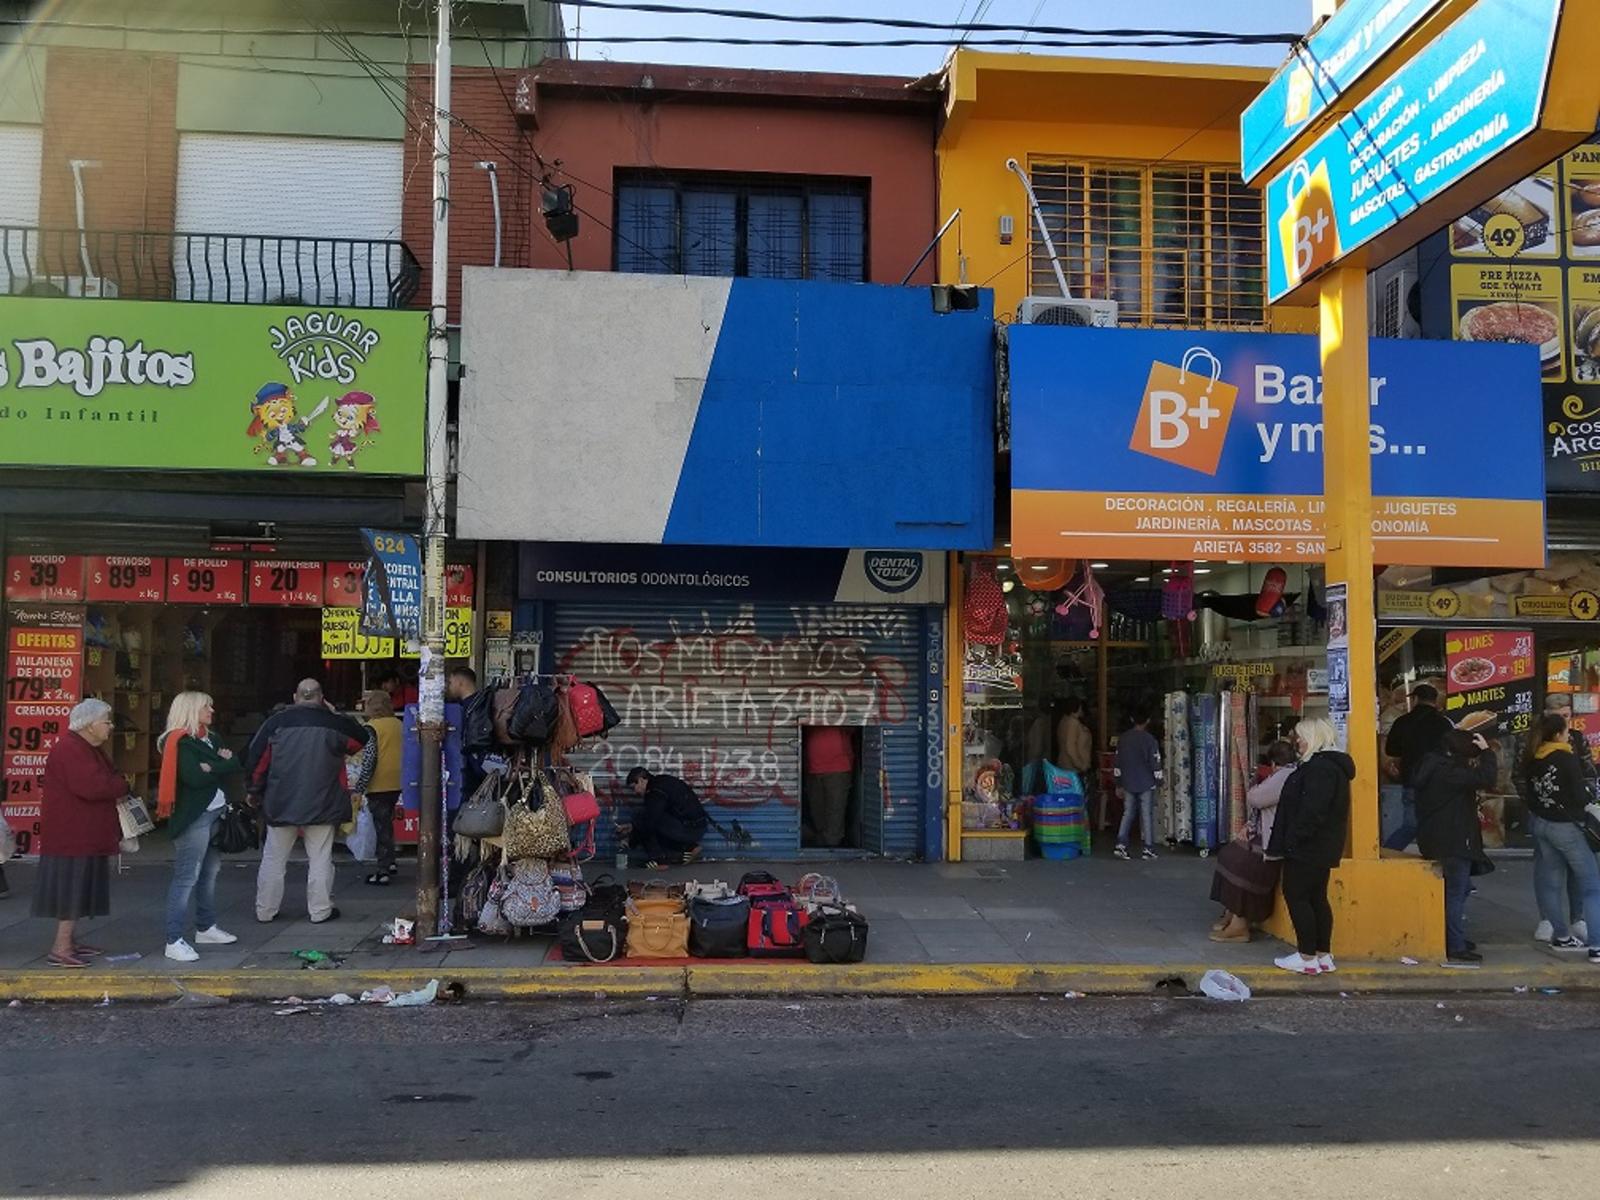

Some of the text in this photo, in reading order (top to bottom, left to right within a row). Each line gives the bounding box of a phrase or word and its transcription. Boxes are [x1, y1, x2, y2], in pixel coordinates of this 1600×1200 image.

[1428, 38, 1487, 102] LIMPIEZA
[1430, 69, 1505, 140] JARDINERÍA
[1414, 113, 1509, 184] GASTRONOMÍA
[1490, 228, 1516, 246] 49
[1480, 271, 1542, 282] PRE PIZZA
[1504, 282, 1542, 291] TOMATE
[268, 312, 381, 354] JAGUAR
[13, 335, 195, 397] Bajitos
[1255, 364, 1386, 406] Bar
[45, 407, 158, 423] Infantil
[1256, 423, 1427, 462] y ms...
[1105, 496, 1204, 512] DECORACIÓN
[1216, 498, 1297, 513] REGALERÍA
[1383, 502, 1457, 516] JUGUETES
[1136, 515, 1220, 530] JARDINERÍA
[1232, 518, 1312, 531] MASCOTAS
[374, 536, 405, 555] 624
[1193, 541, 1244, 553] ARIETA
[1248, 542, 1282, 554] 3582
[106, 556, 151, 566] CREMOSO
[183, 558, 228, 568] DE POLLO
[871, 558, 917, 568] DENTAL
[30, 563, 58, 586] 39
[188, 569, 215, 592] 99
[270, 568, 298, 591] 20
[537, 570, 750, 587] CONSULTORIOS ODONTOLÓGICOS
[876, 568, 909, 577] TOTAL
[16, 633, 76, 648] OFERTAS
[16, 656, 74, 667] MILANESA
[592, 634, 867, 678] NOS MUDAMOS
[17, 667, 72, 678] DE POLLO
[624, 682, 760, 729] ARIETA
[1467, 687, 1506, 706] MARTES
[15, 705, 70, 715] CREMOSO
[7, 726, 41, 750] 99
